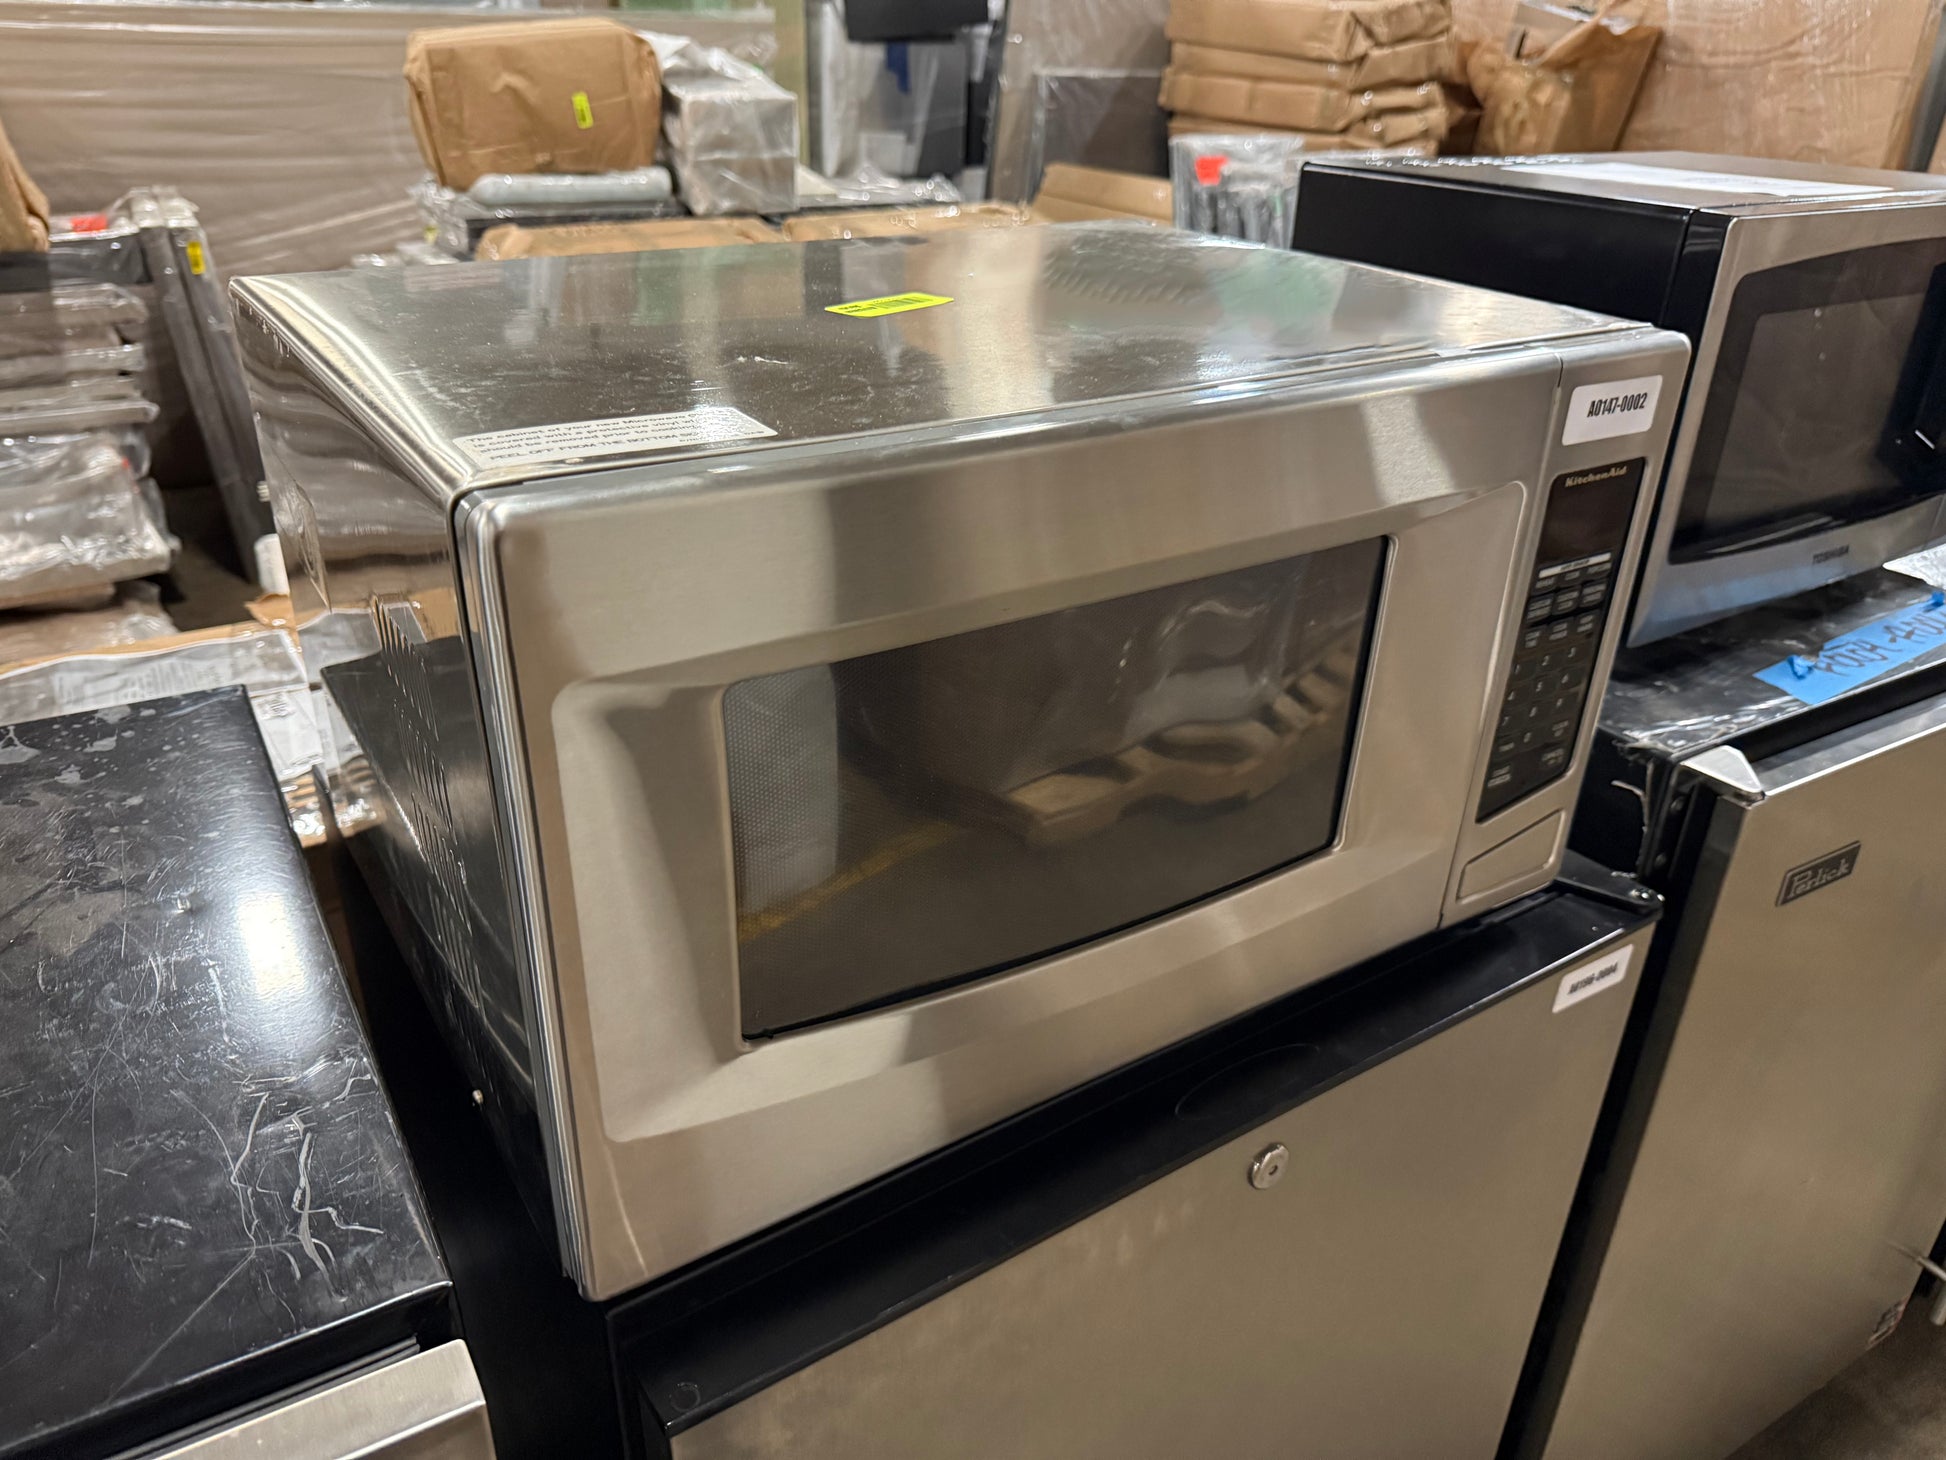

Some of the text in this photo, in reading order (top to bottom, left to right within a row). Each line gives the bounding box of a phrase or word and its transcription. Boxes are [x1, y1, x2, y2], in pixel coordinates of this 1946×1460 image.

[1587, 392, 1648, 418] A0147-0002
[496, 429, 545, 439] cabinet
[622, 415, 686, 424] Microwave
[480, 444, 521, 453] should
[545, 434, 598, 444] removed
[489, 435, 541, 446] covered
[1565, 465, 1628, 488] KitchenAid
[1786, 857, 1850, 899] Perlick
